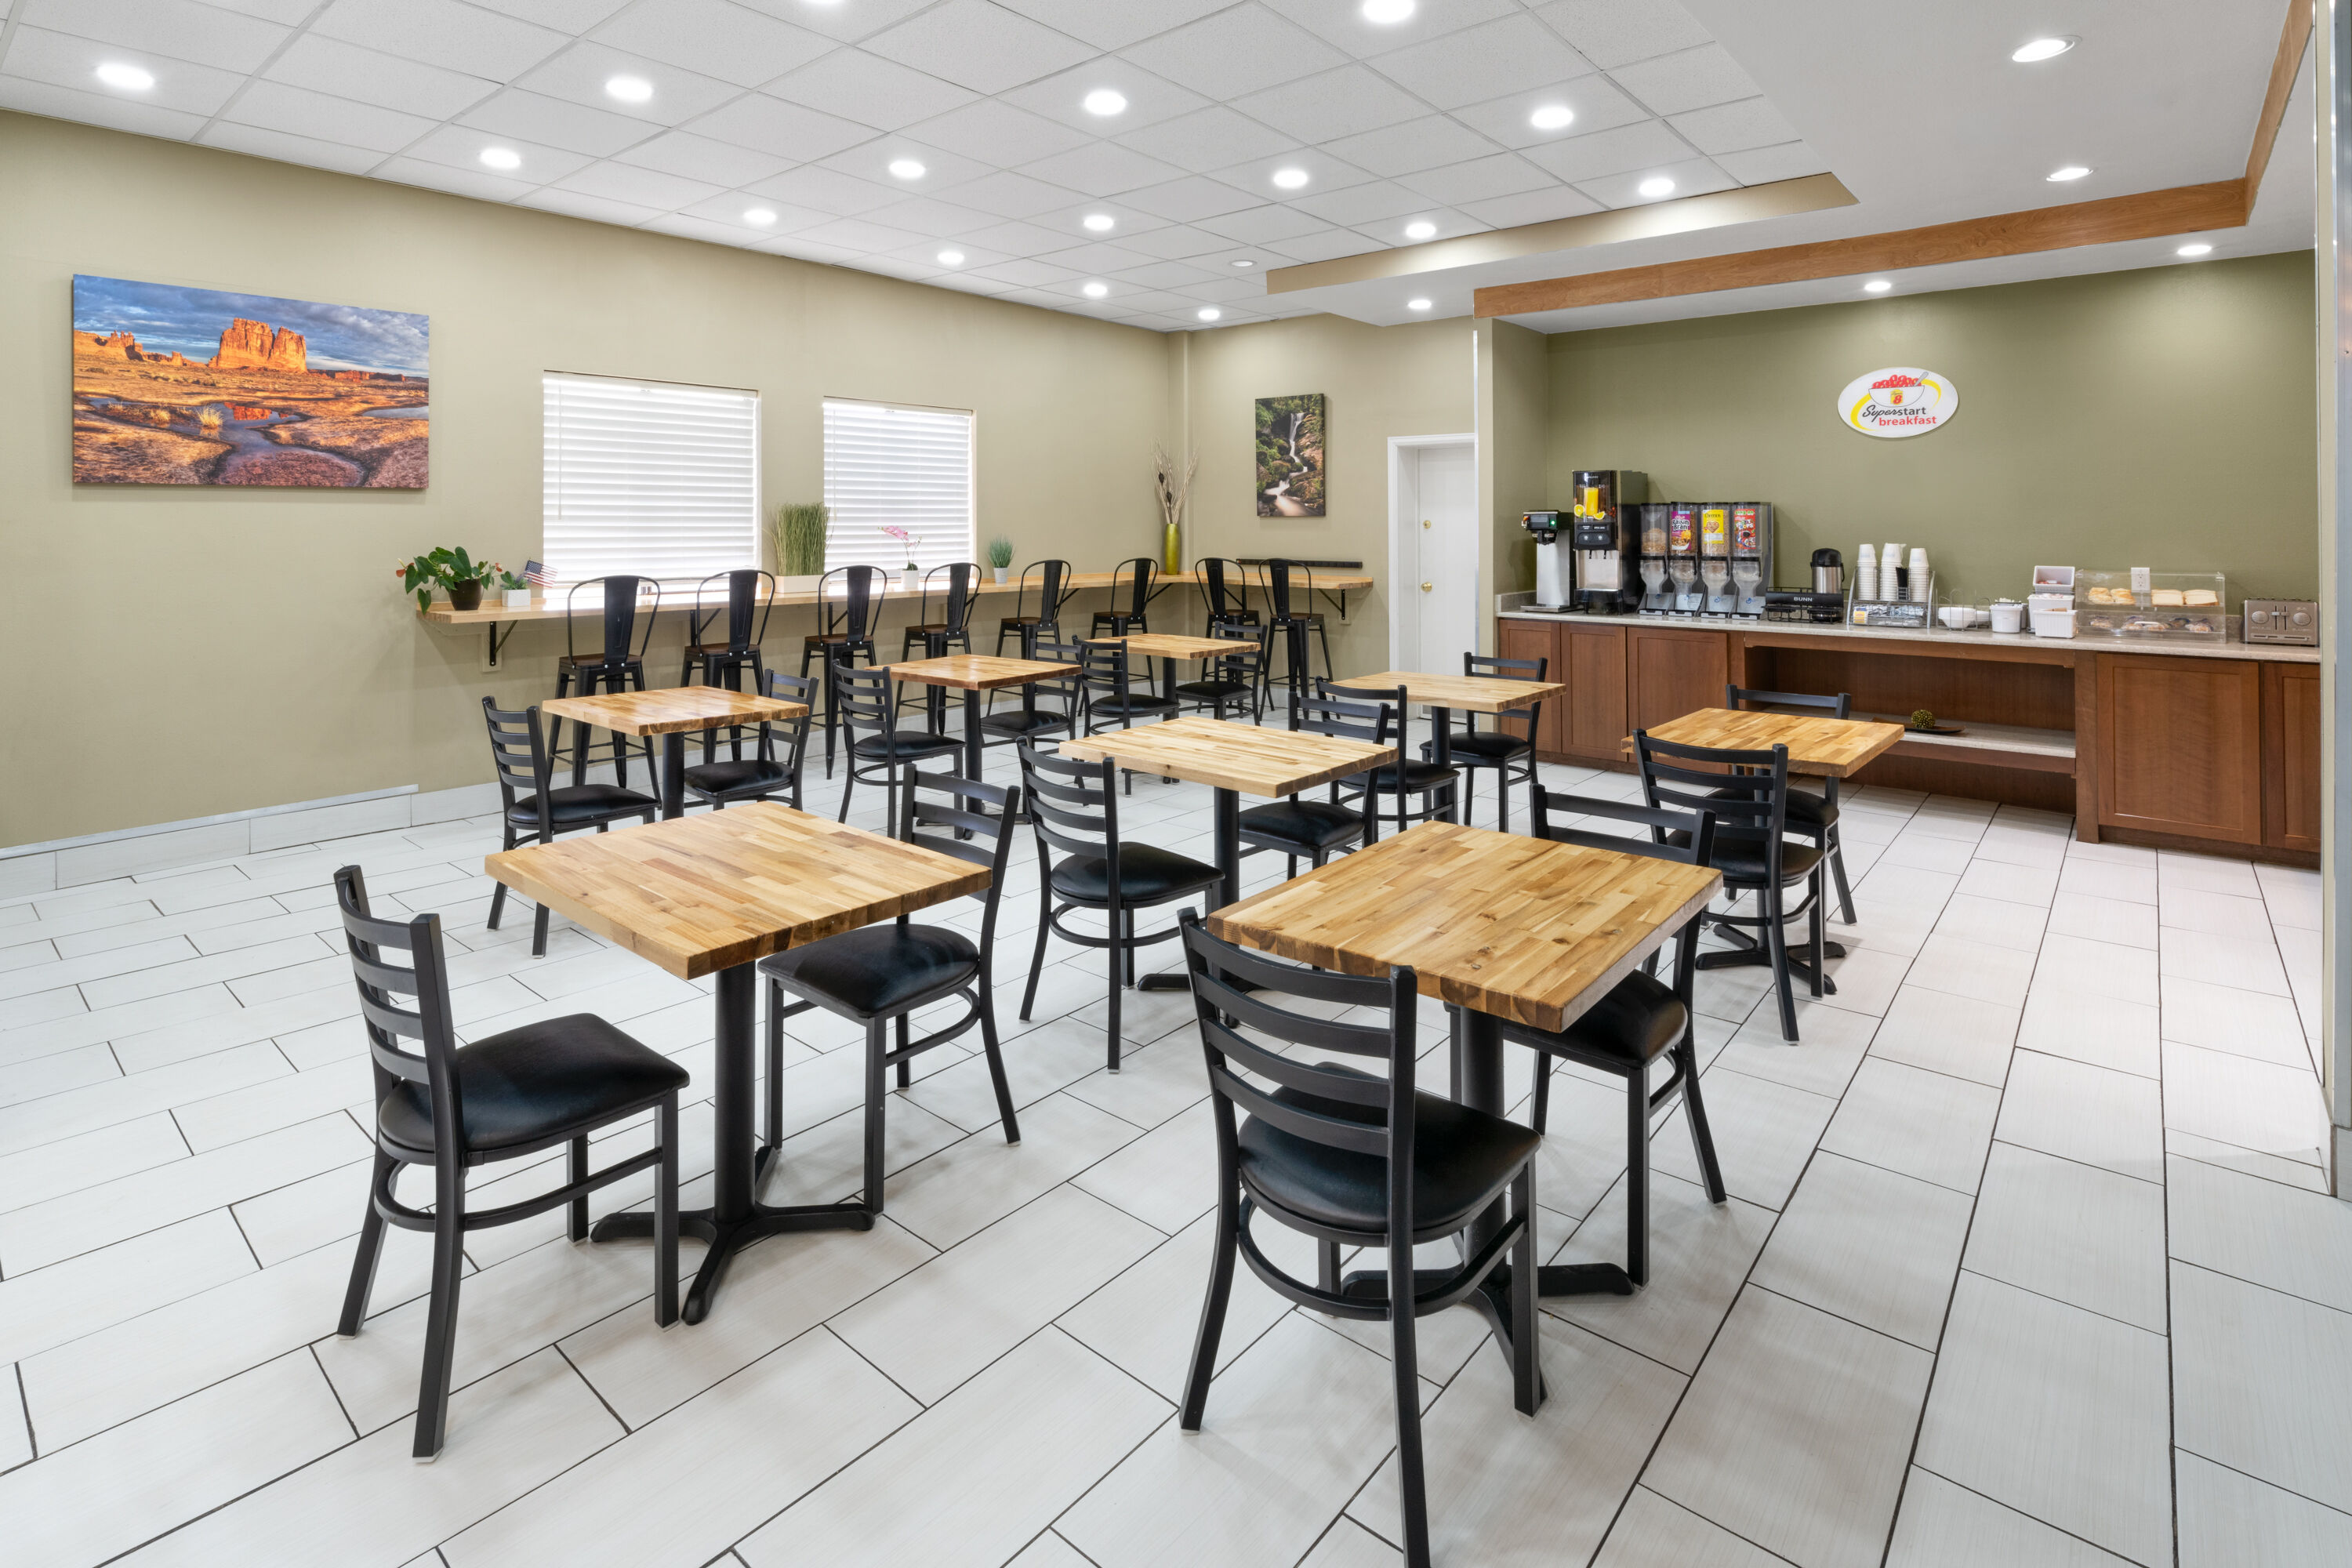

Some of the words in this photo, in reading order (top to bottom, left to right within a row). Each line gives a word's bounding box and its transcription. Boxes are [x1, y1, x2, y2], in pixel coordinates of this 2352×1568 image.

[1893, 395, 1902, 404] 8
[1862, 405, 1926, 423] Superstart
[1878, 416, 1937, 426] breakfast
